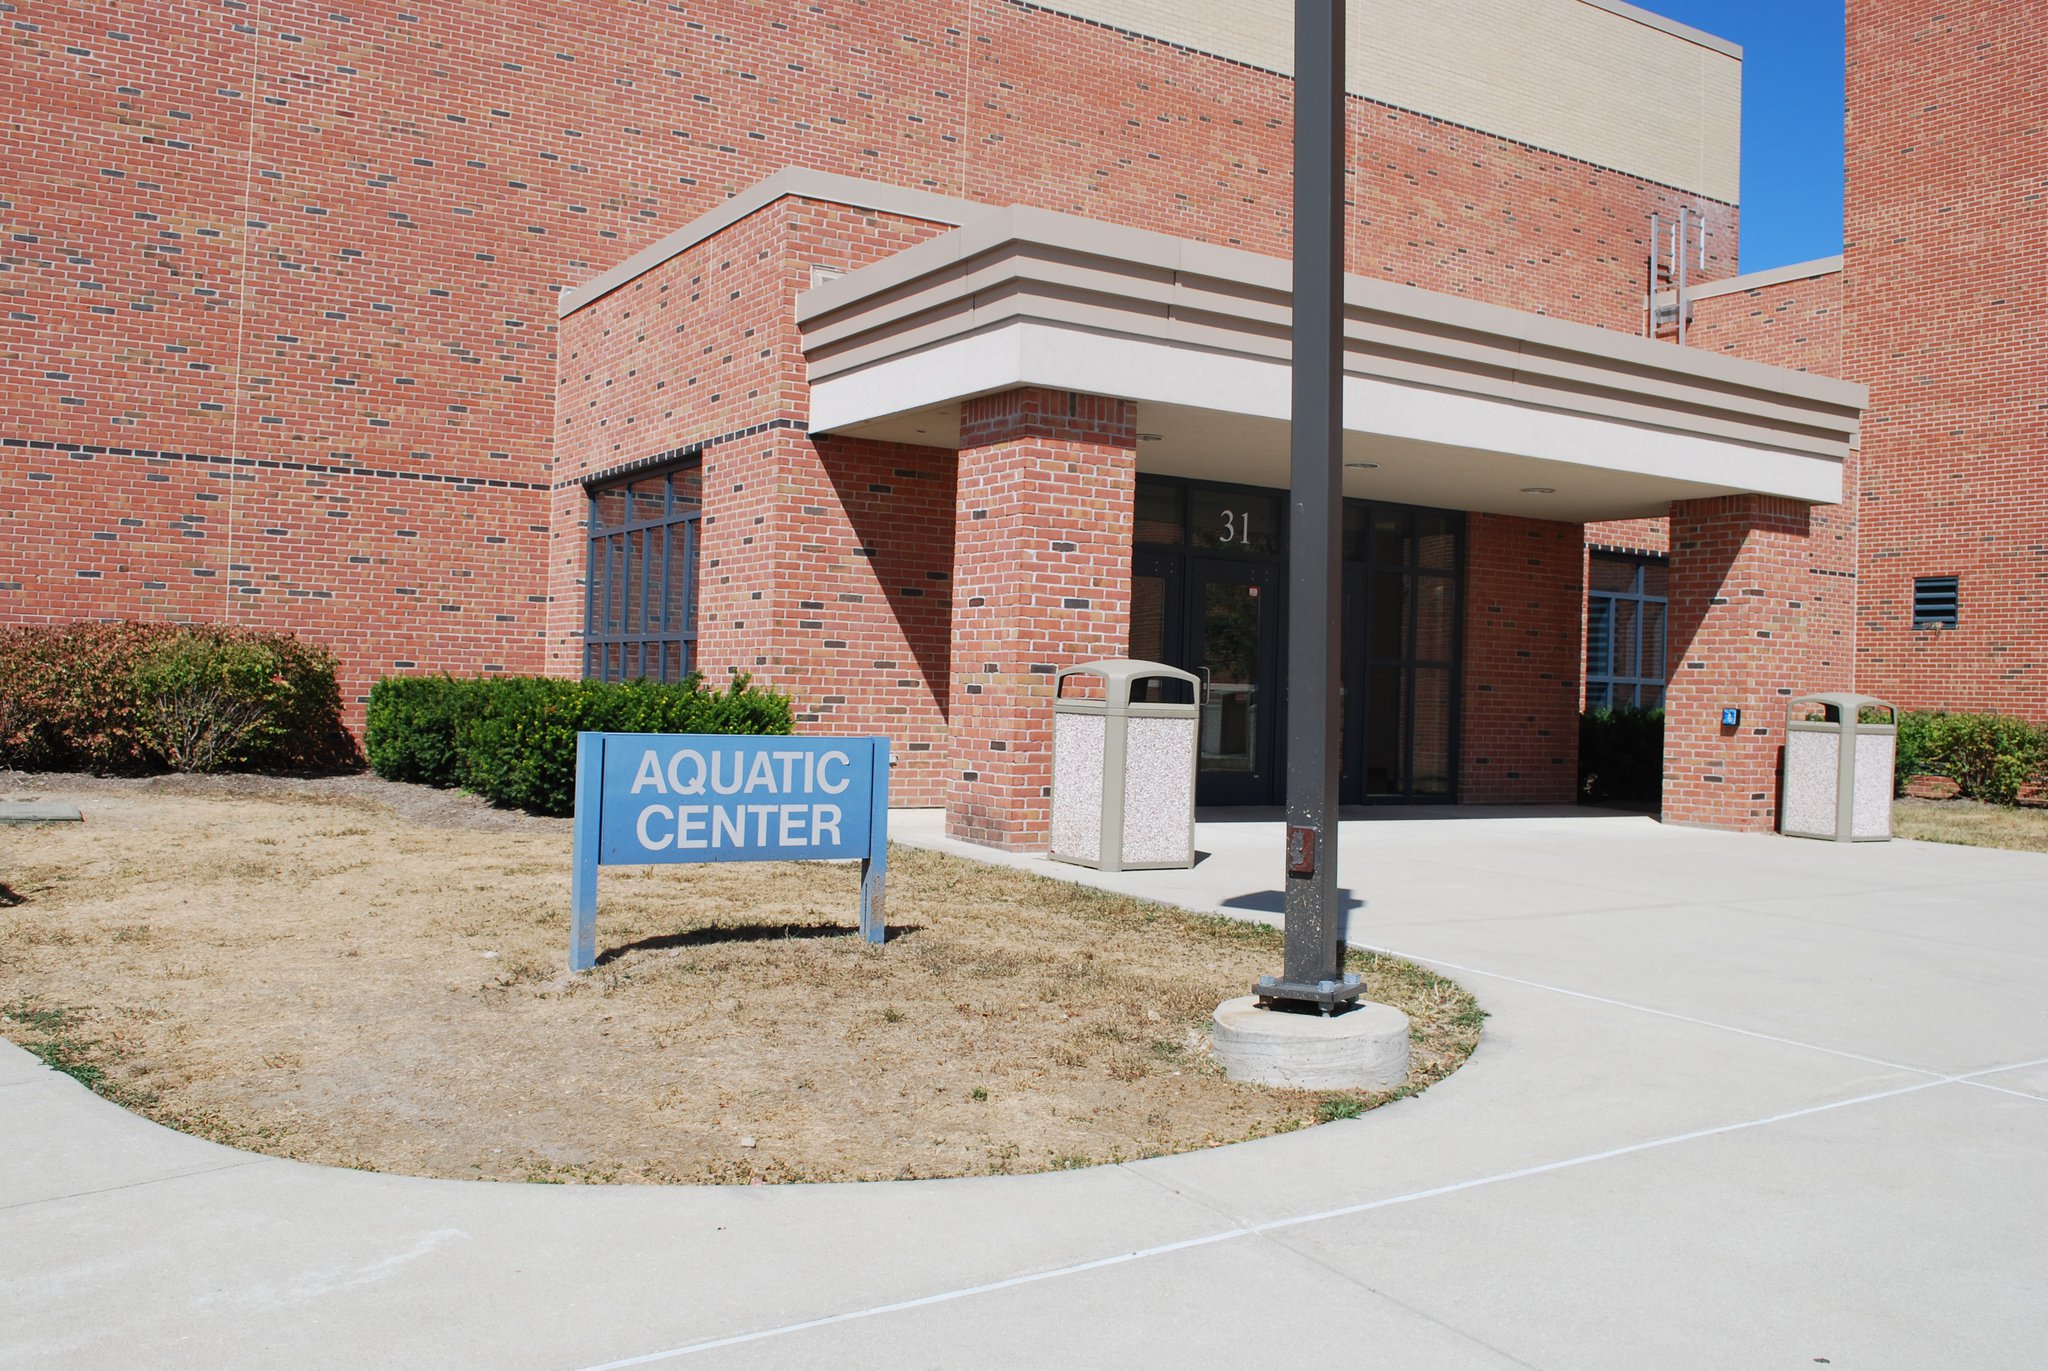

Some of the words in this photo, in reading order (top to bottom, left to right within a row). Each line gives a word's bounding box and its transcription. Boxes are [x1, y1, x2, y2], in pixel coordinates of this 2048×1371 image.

[1219, 510, 1250, 544] 31
[630, 749, 850, 796] AQUATIC
[636, 803, 843, 851] CENTER
